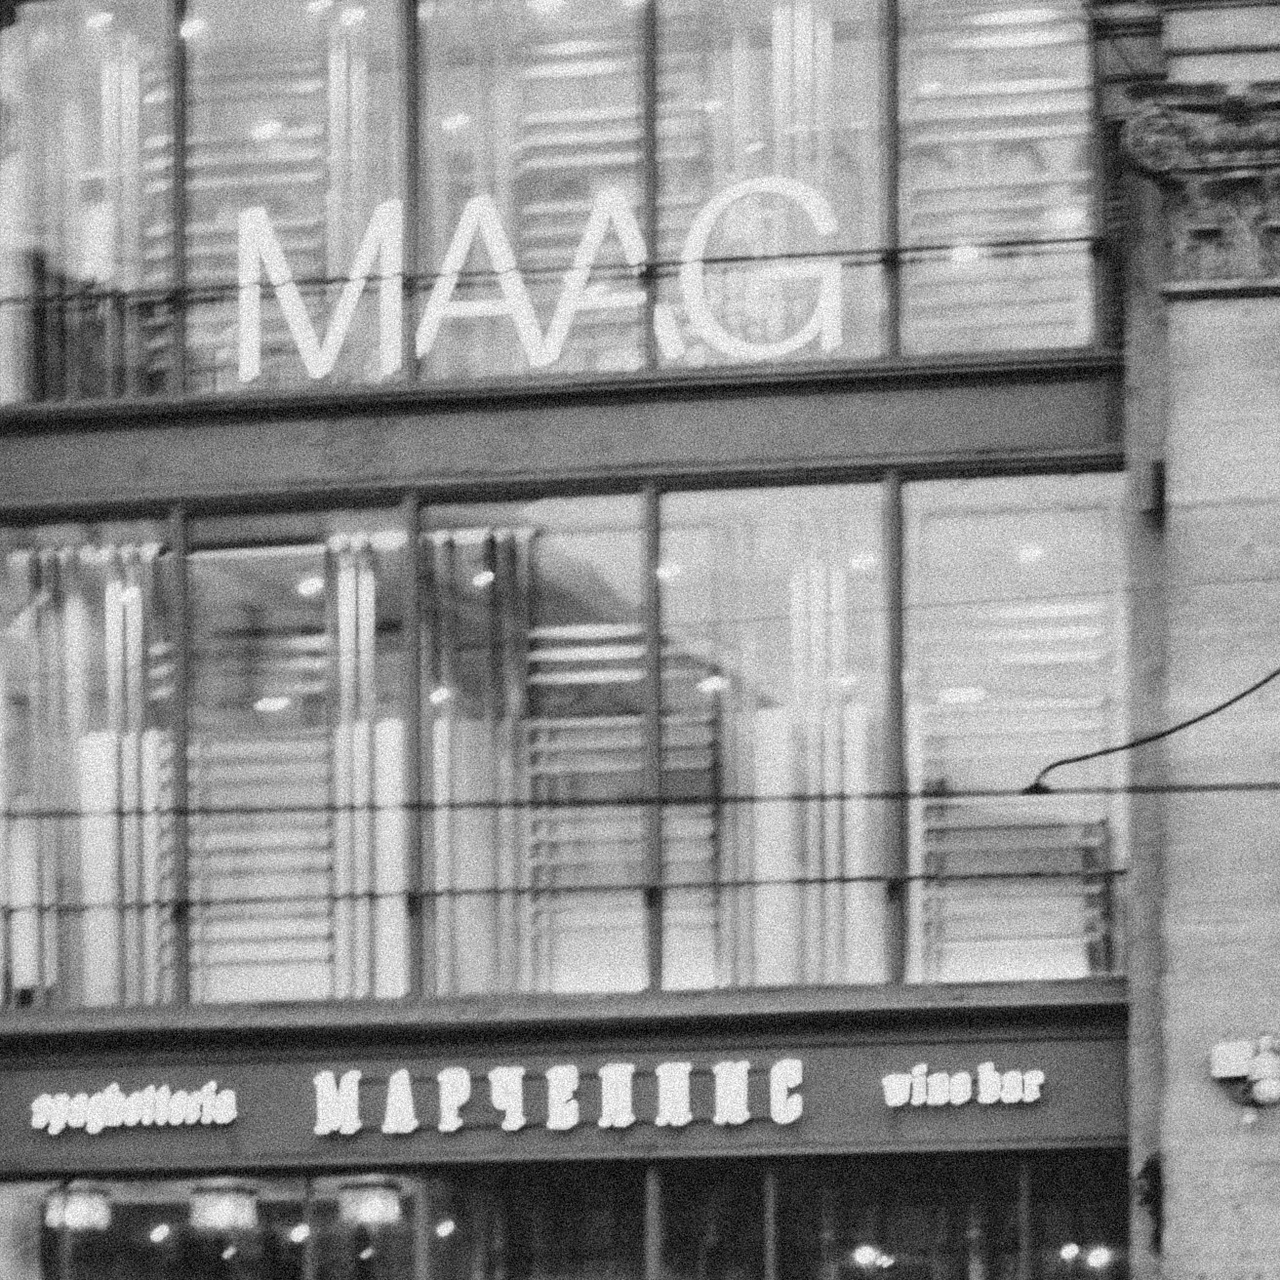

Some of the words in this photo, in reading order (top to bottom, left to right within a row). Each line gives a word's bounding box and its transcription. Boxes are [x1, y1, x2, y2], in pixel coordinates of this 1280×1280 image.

[236, 175, 844, 383] MAAG
[881, 1062, 972, 1106] wine
[977, 1060, 1046, 1104] bar
